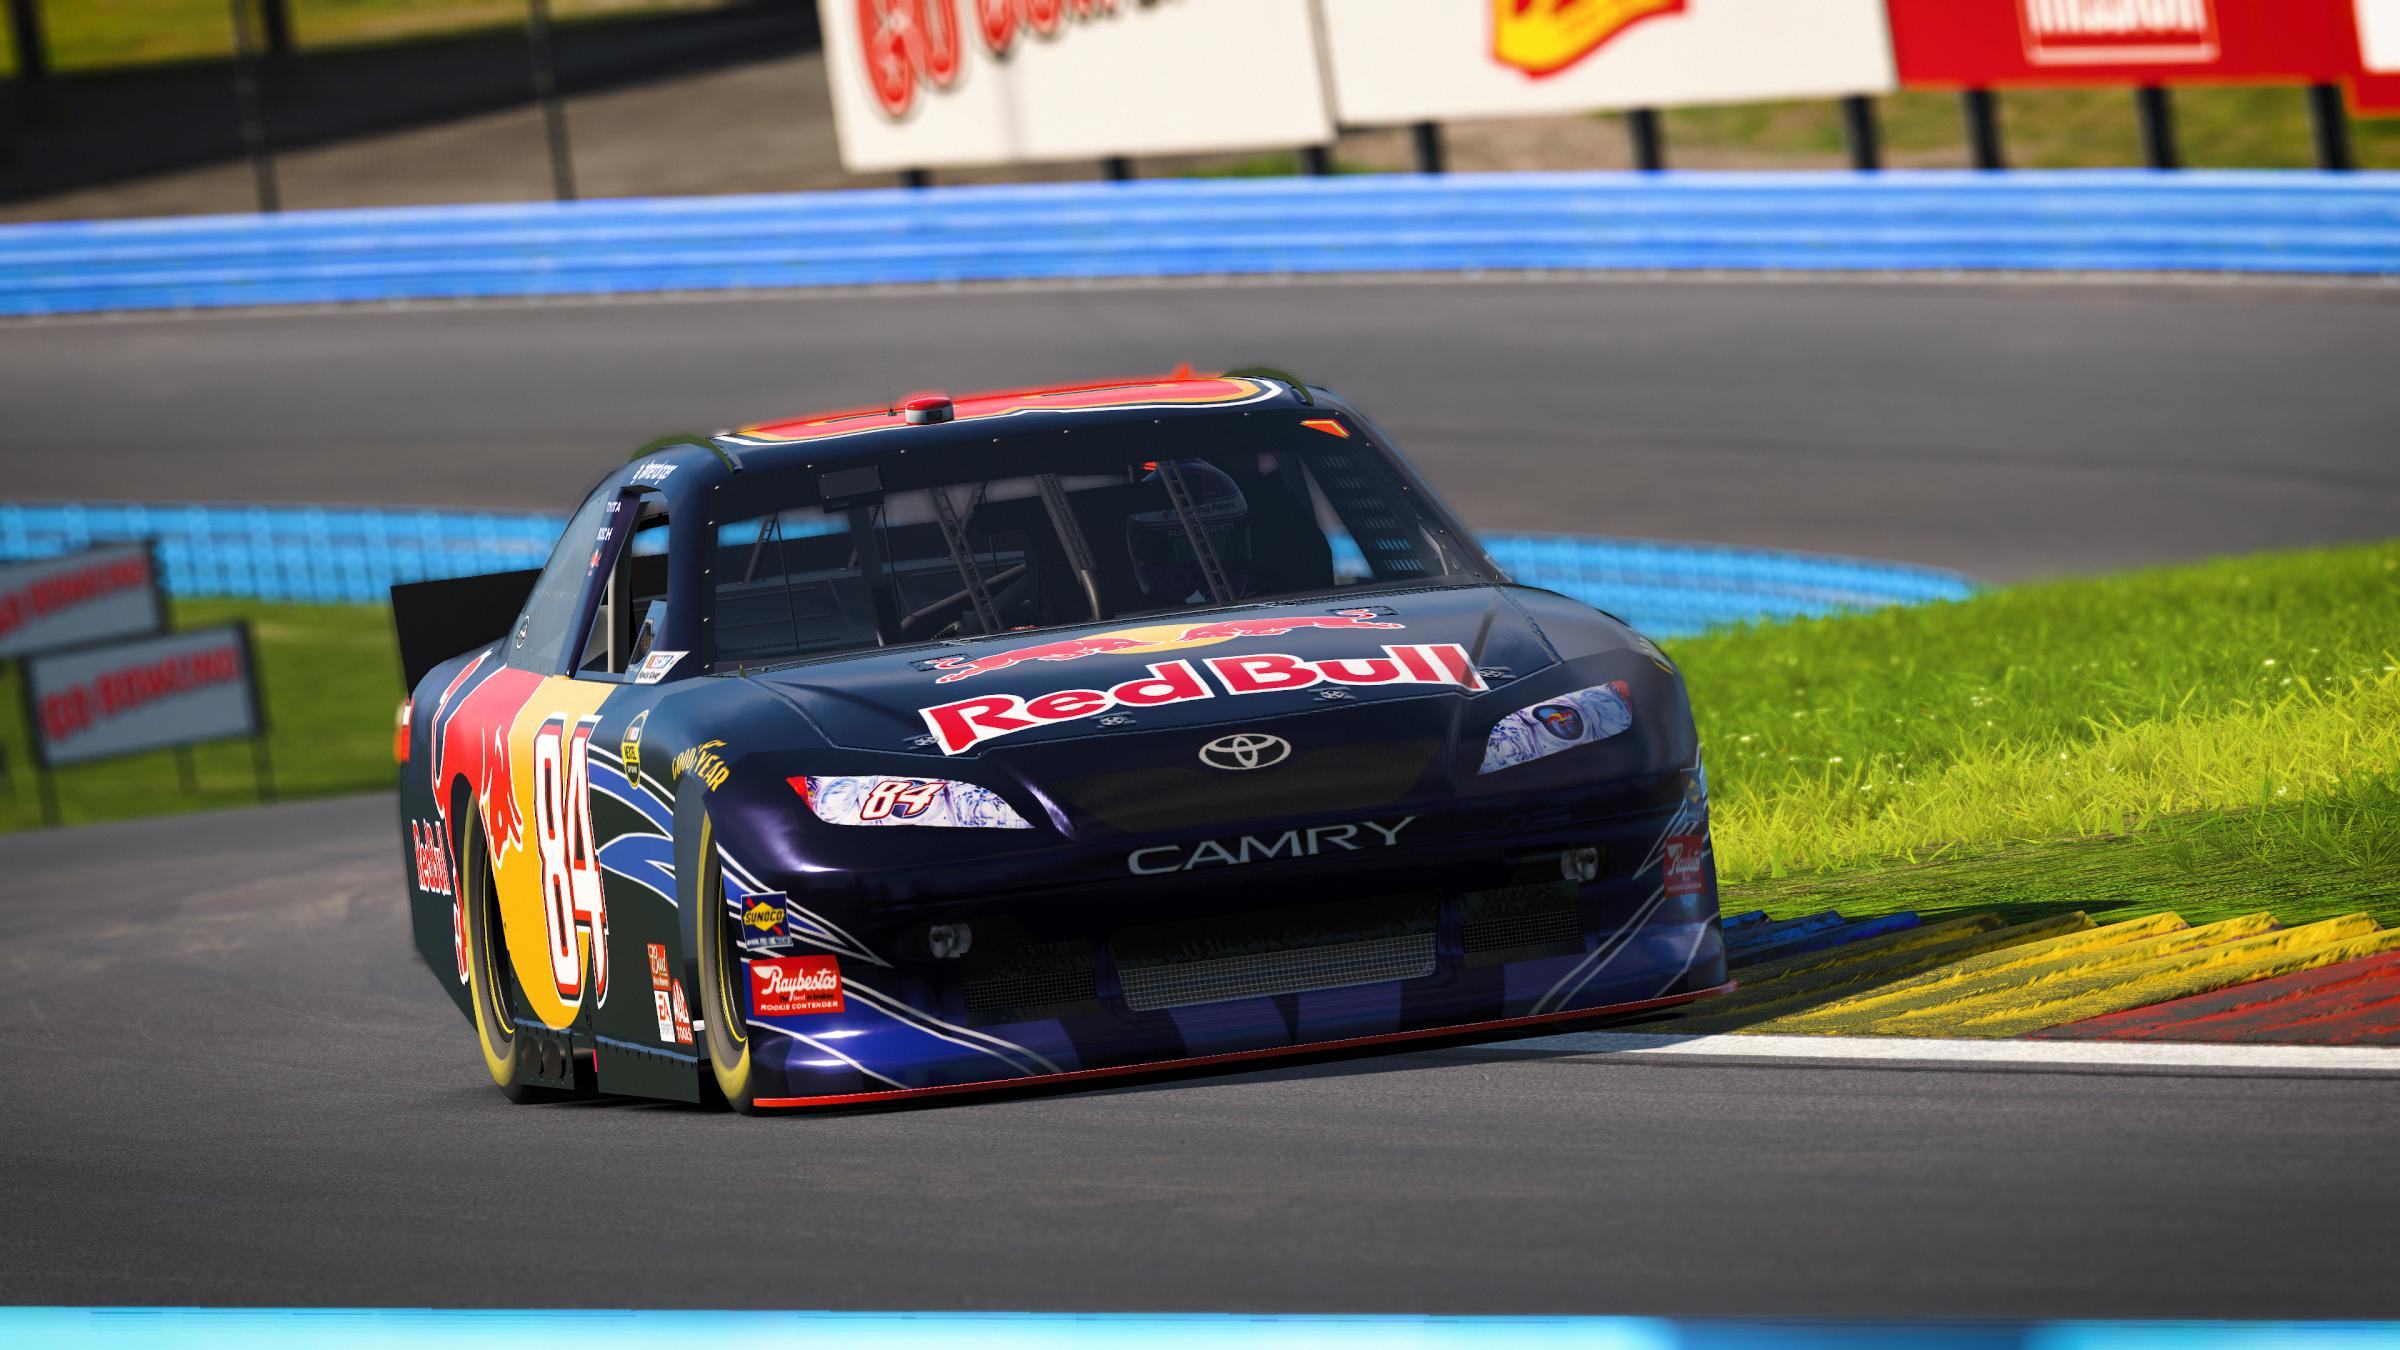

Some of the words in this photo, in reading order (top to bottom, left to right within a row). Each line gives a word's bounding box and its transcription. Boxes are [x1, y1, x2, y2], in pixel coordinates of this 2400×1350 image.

[918, 658, 1215, 755] Red
[1204, 643, 1491, 695] Bull
[860, 780, 949, 820] 84
[534, 712, 609, 1010] 84
[1127, 815, 1418, 876] CAMRY
[745, 909, 783, 924] SUNOCO
[752, 964, 837, 1001] Raybestos
[760, 1003, 790, 1011] ROOKIE
[791, 1001, 838, 1010] CONTENDER
